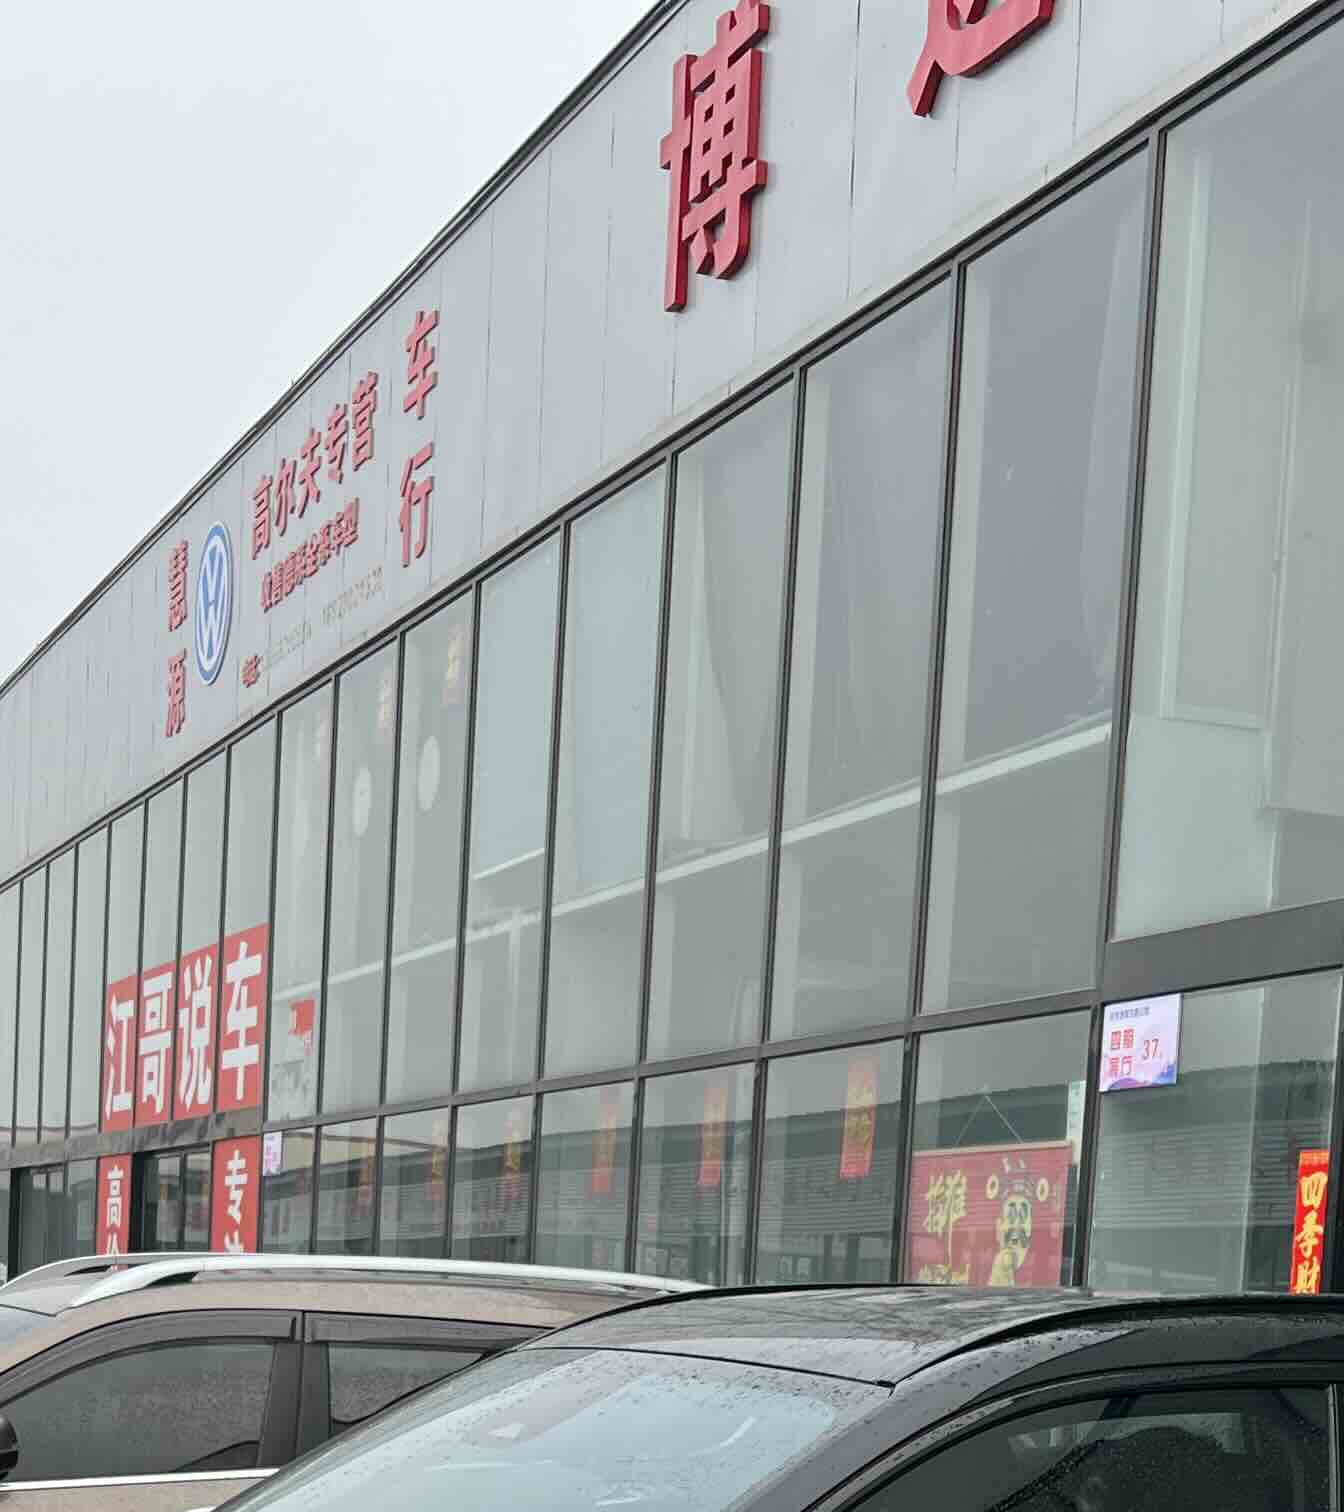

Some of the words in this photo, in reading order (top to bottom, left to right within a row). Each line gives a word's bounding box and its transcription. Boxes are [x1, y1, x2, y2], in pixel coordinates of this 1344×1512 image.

[250, 371, 379, 560] 高尔夫专营
[400, 310, 440, 567] 车行
[104, 940, 263, 1120] 江哥说车
